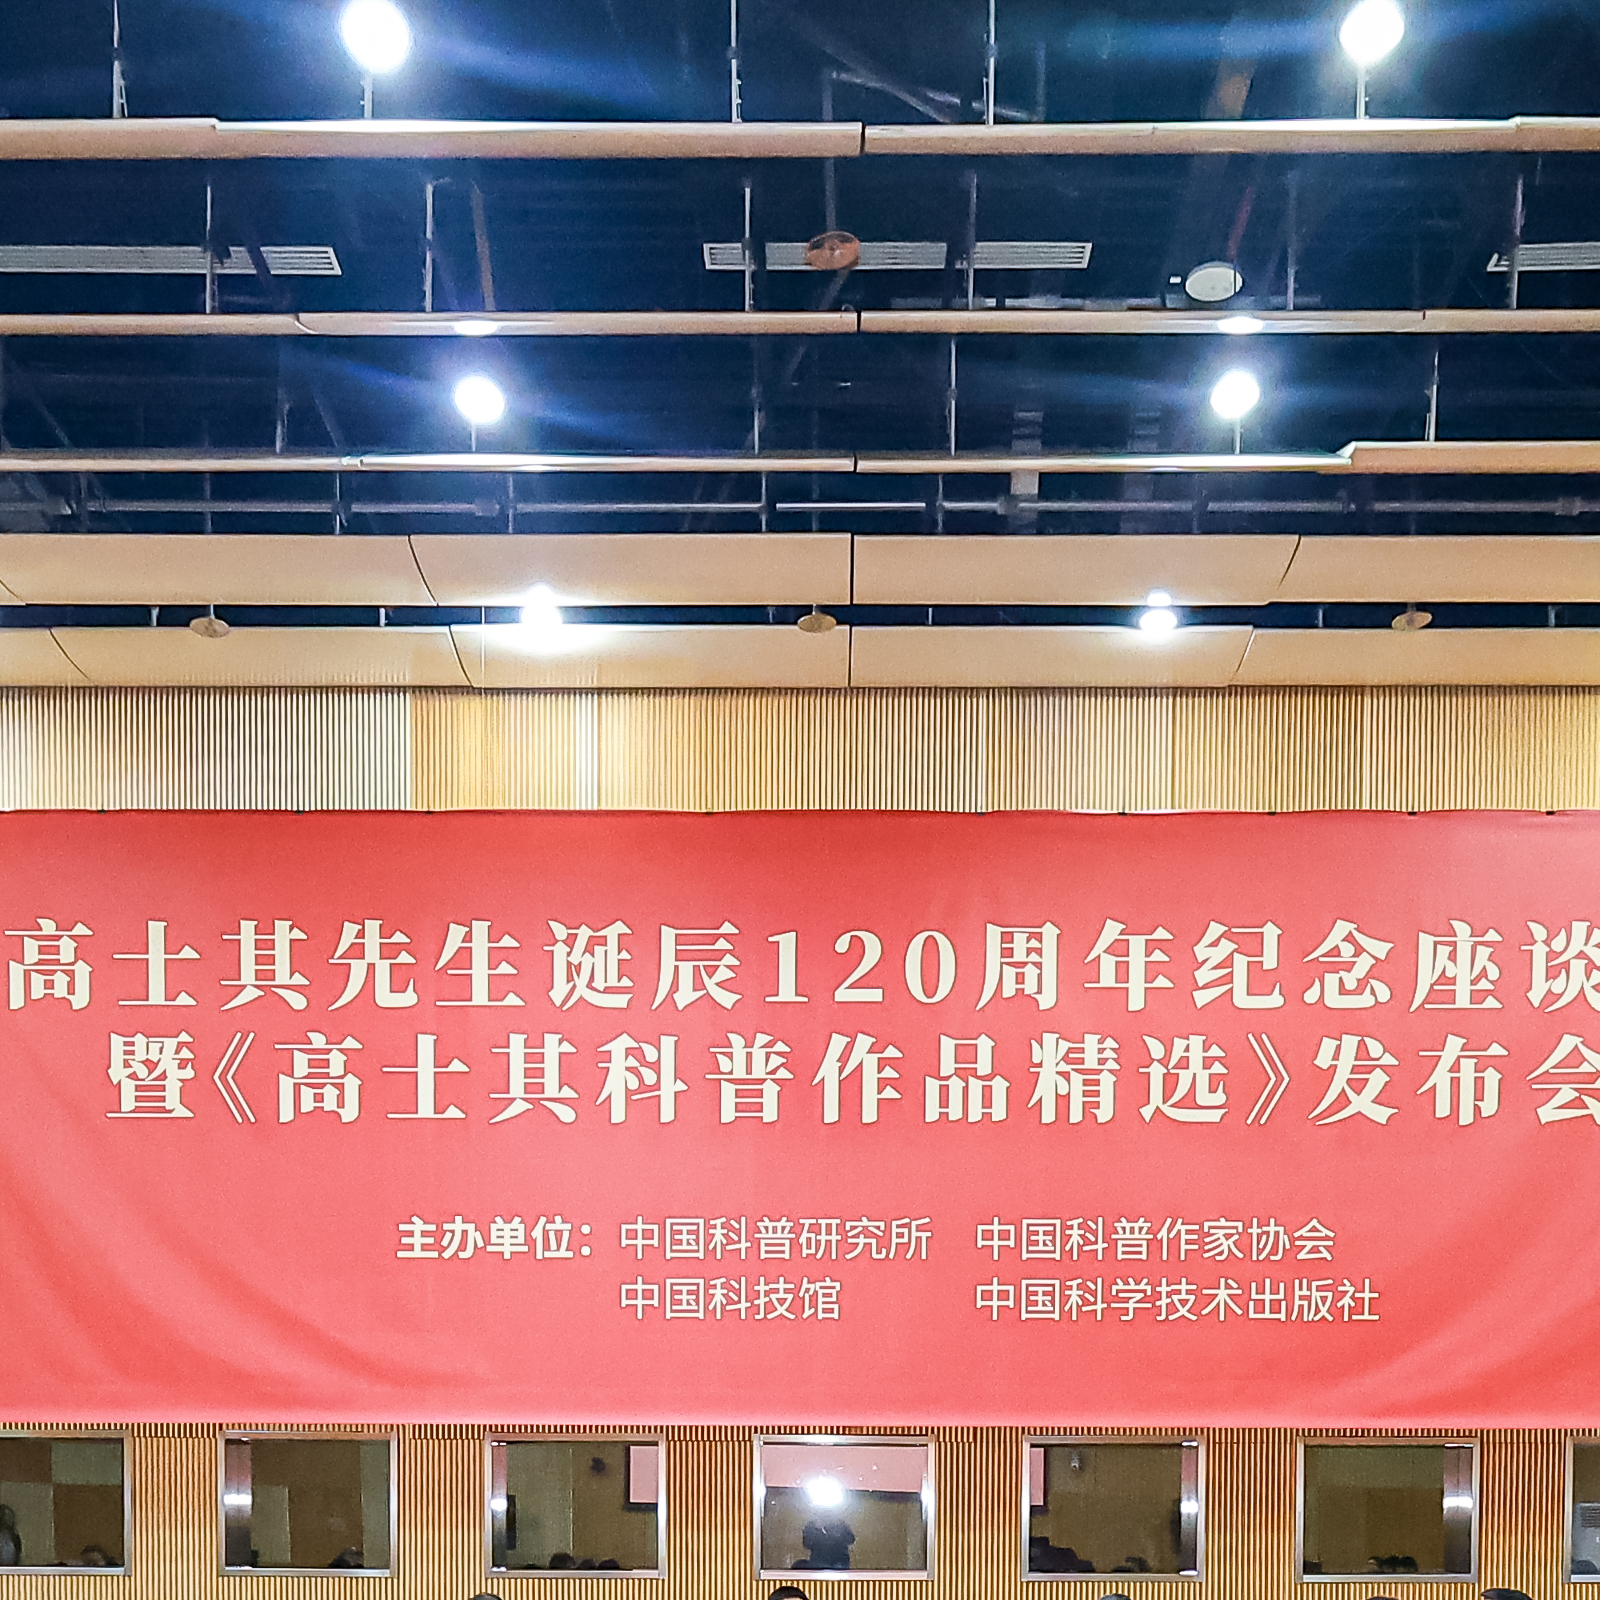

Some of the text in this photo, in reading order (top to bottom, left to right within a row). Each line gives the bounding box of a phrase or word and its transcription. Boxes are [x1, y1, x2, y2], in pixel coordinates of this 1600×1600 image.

[620, 1215, 932, 1260] 中国科普研究所
[976, 1216, 1336, 1261] 中国科普作家协会
[620, 1275, 1380, 1322] 中国科技馆 中国科学技术出版社
